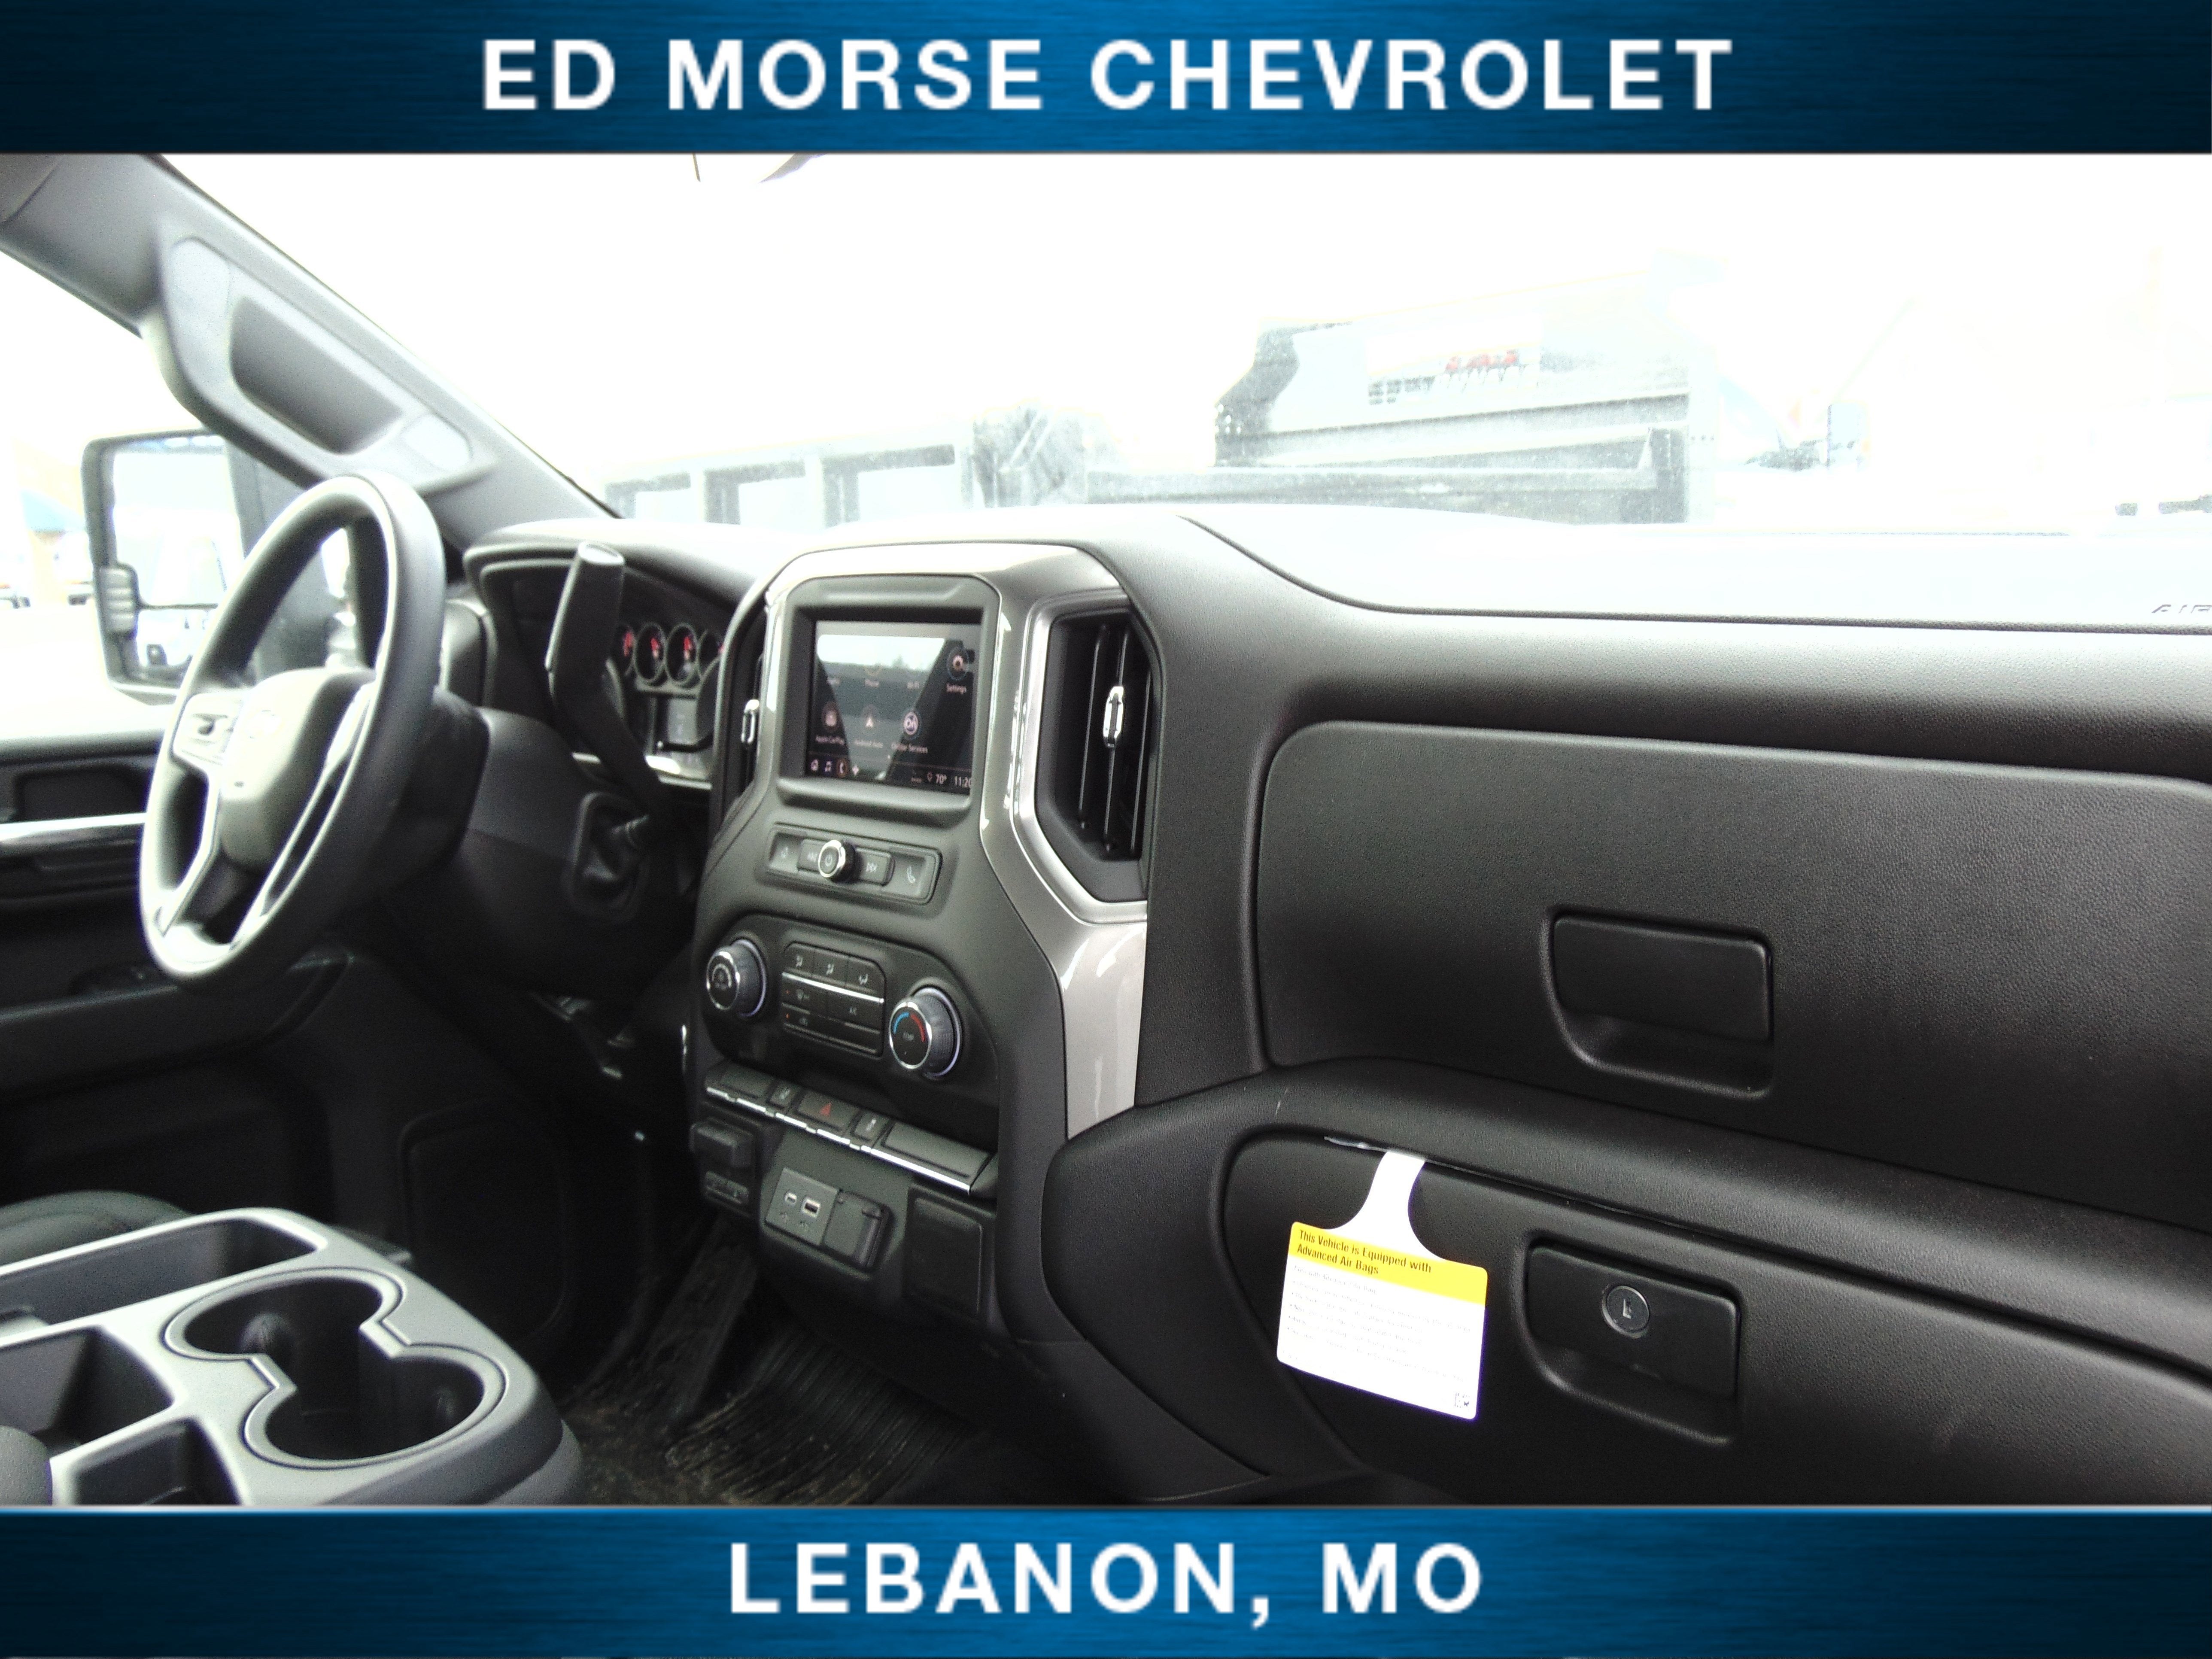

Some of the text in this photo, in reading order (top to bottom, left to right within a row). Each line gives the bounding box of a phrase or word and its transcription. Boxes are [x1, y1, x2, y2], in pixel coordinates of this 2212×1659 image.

[1297, 1243, 1379, 1276] Advanced Air Bags
[1300, 1229, 1432, 1273] This Vehicle is Equipped with
